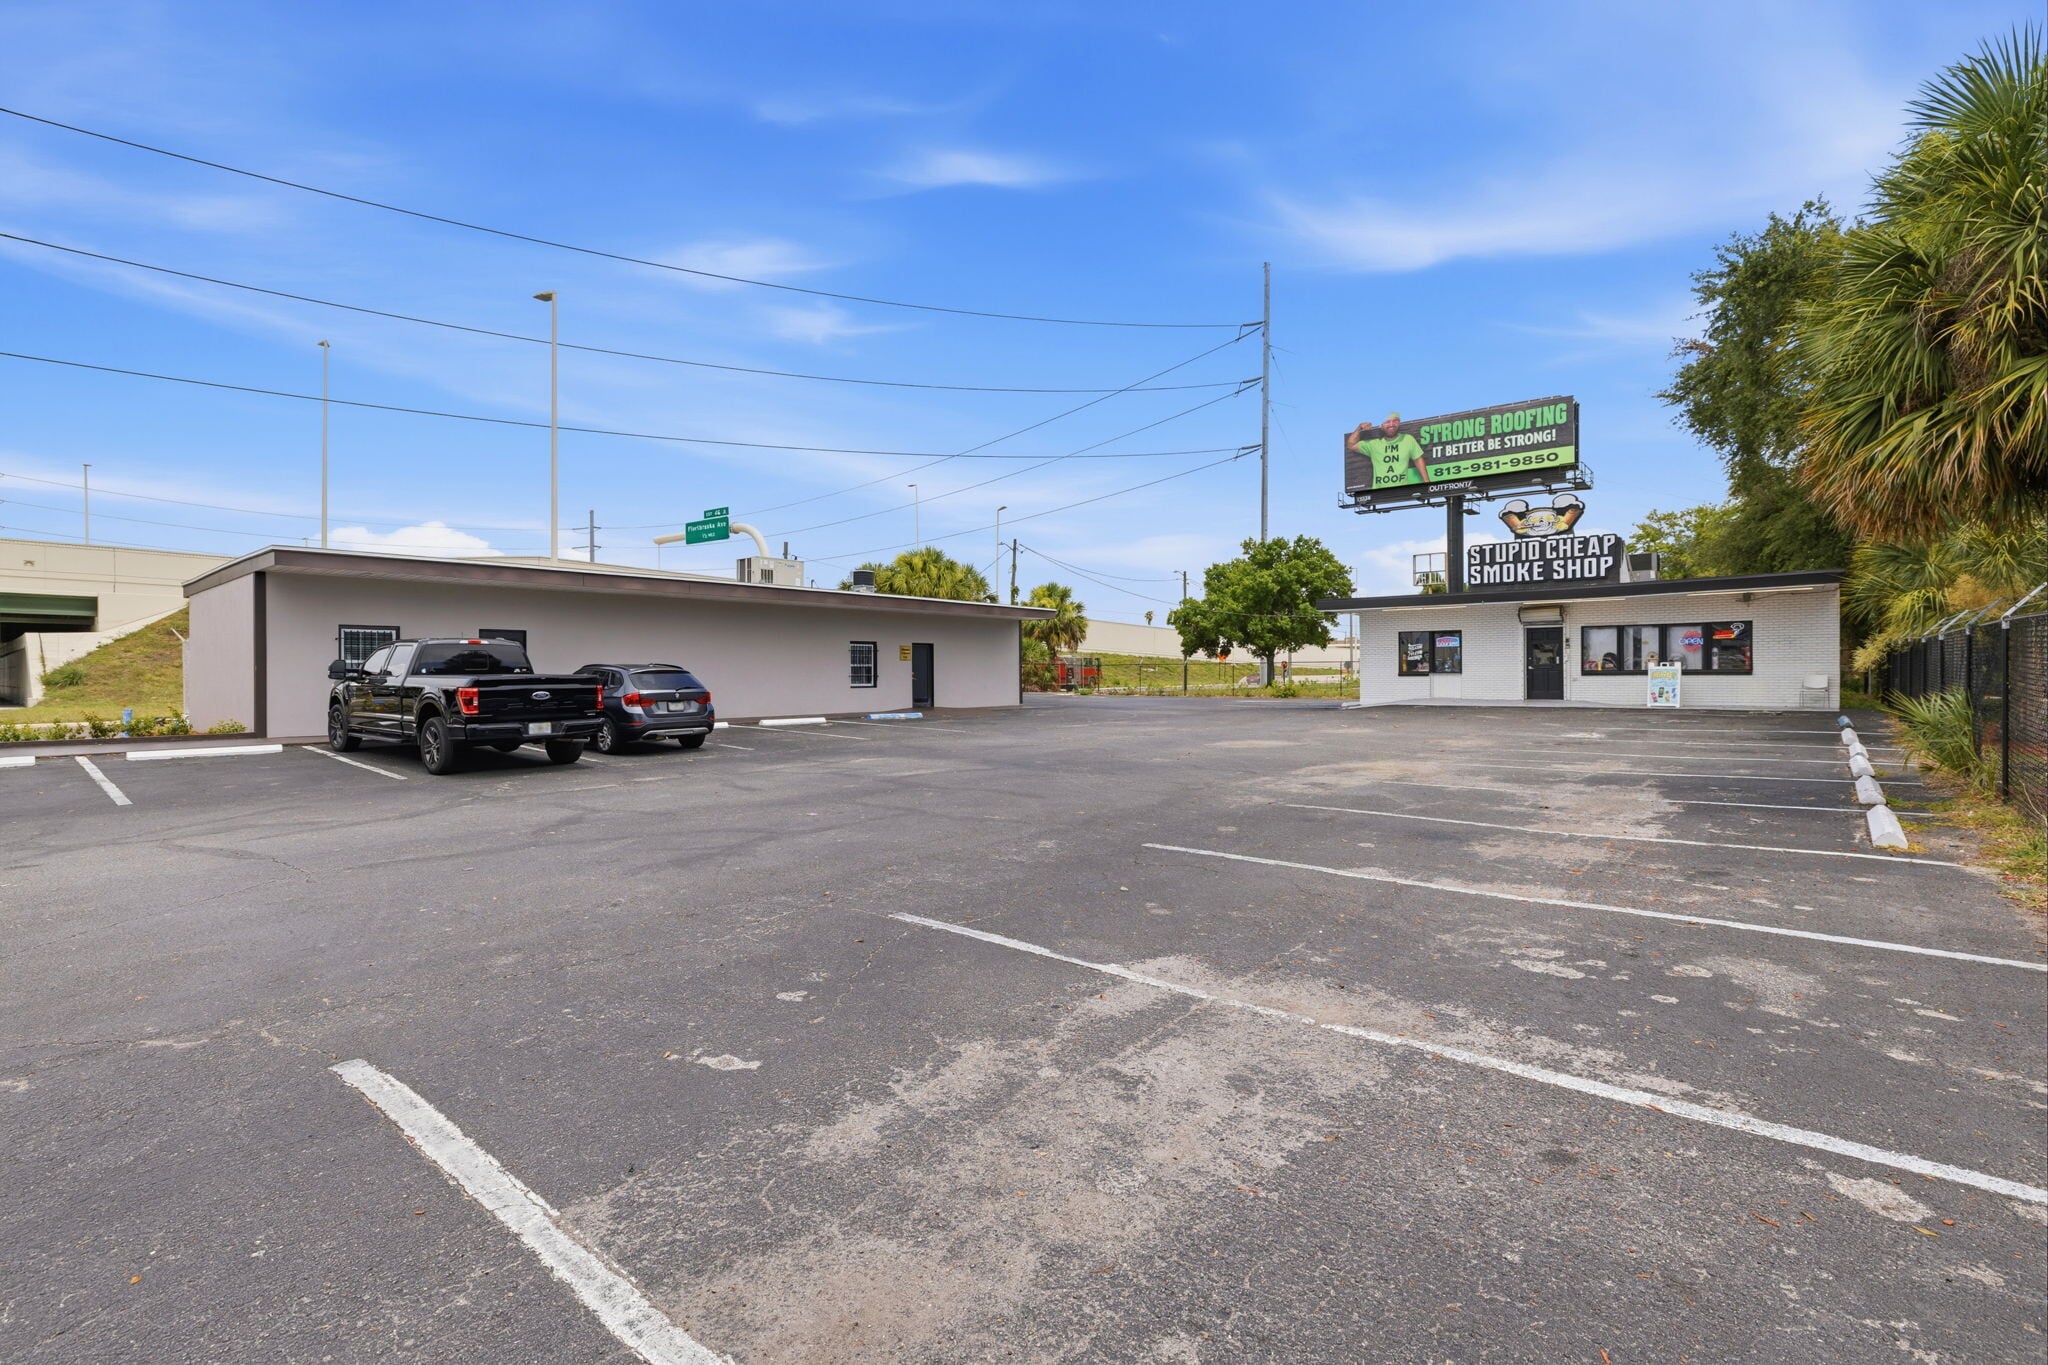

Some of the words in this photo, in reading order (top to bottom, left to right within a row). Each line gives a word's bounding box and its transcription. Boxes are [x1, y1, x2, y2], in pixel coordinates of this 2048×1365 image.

[1420, 417, 1485, 445] STRONG
[1491, 403, 1568, 435] ROOFING
[1385, 445, 1398, 453] I'M
[1432, 445, 1441, 458] IT
[1446, 440, 1485, 457] BETTER
[1488, 437, 1502, 451] BE
[1503, 429, 1556, 449] STRONG!
[1383, 455, 1399, 463] ON
[1433, 451, 1559, 477] 813-981-9850
[1387, 465, 1395, 473] A
[1376, 474, 1406, 484] ROOF
[1470, 541, 1540, 565] STUPID
[1546, 535, 1615, 559] CHEAP
[1470, 561, 1544, 584] SMOKE
[1553, 556, 1614, 580] SHOP
[1679, 637, 1704, 646] OPEN
